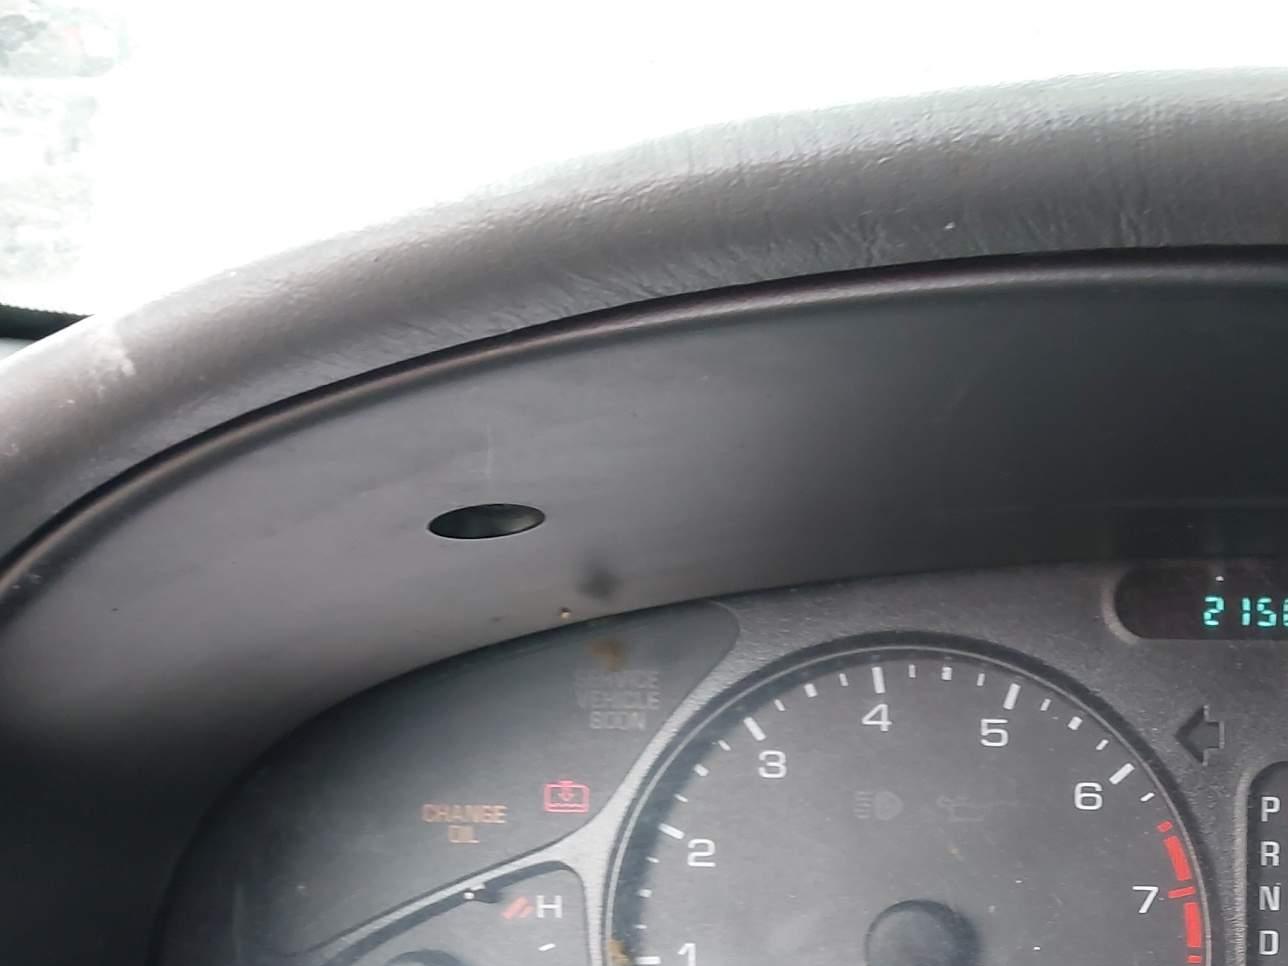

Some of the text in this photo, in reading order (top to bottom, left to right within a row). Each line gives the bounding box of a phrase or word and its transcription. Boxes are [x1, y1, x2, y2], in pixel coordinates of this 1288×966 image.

[862, 704, 892, 731] 4
[981, 719, 1007, 746] 5
[759, 751, 786, 778] 3
[1075, 783, 1102, 809] 6
[422, 804, 507, 823] CHANGE
[1262, 797, 1280, 821] P
[688, 839, 715, 867] 2
[1262, 841, 1279, 866] R
[537, 896, 562, 918] H
[1133, 886, 1158, 913] 7
[1260, 887, 1280, 910] N
[1260, 931, 1278, 955] D
